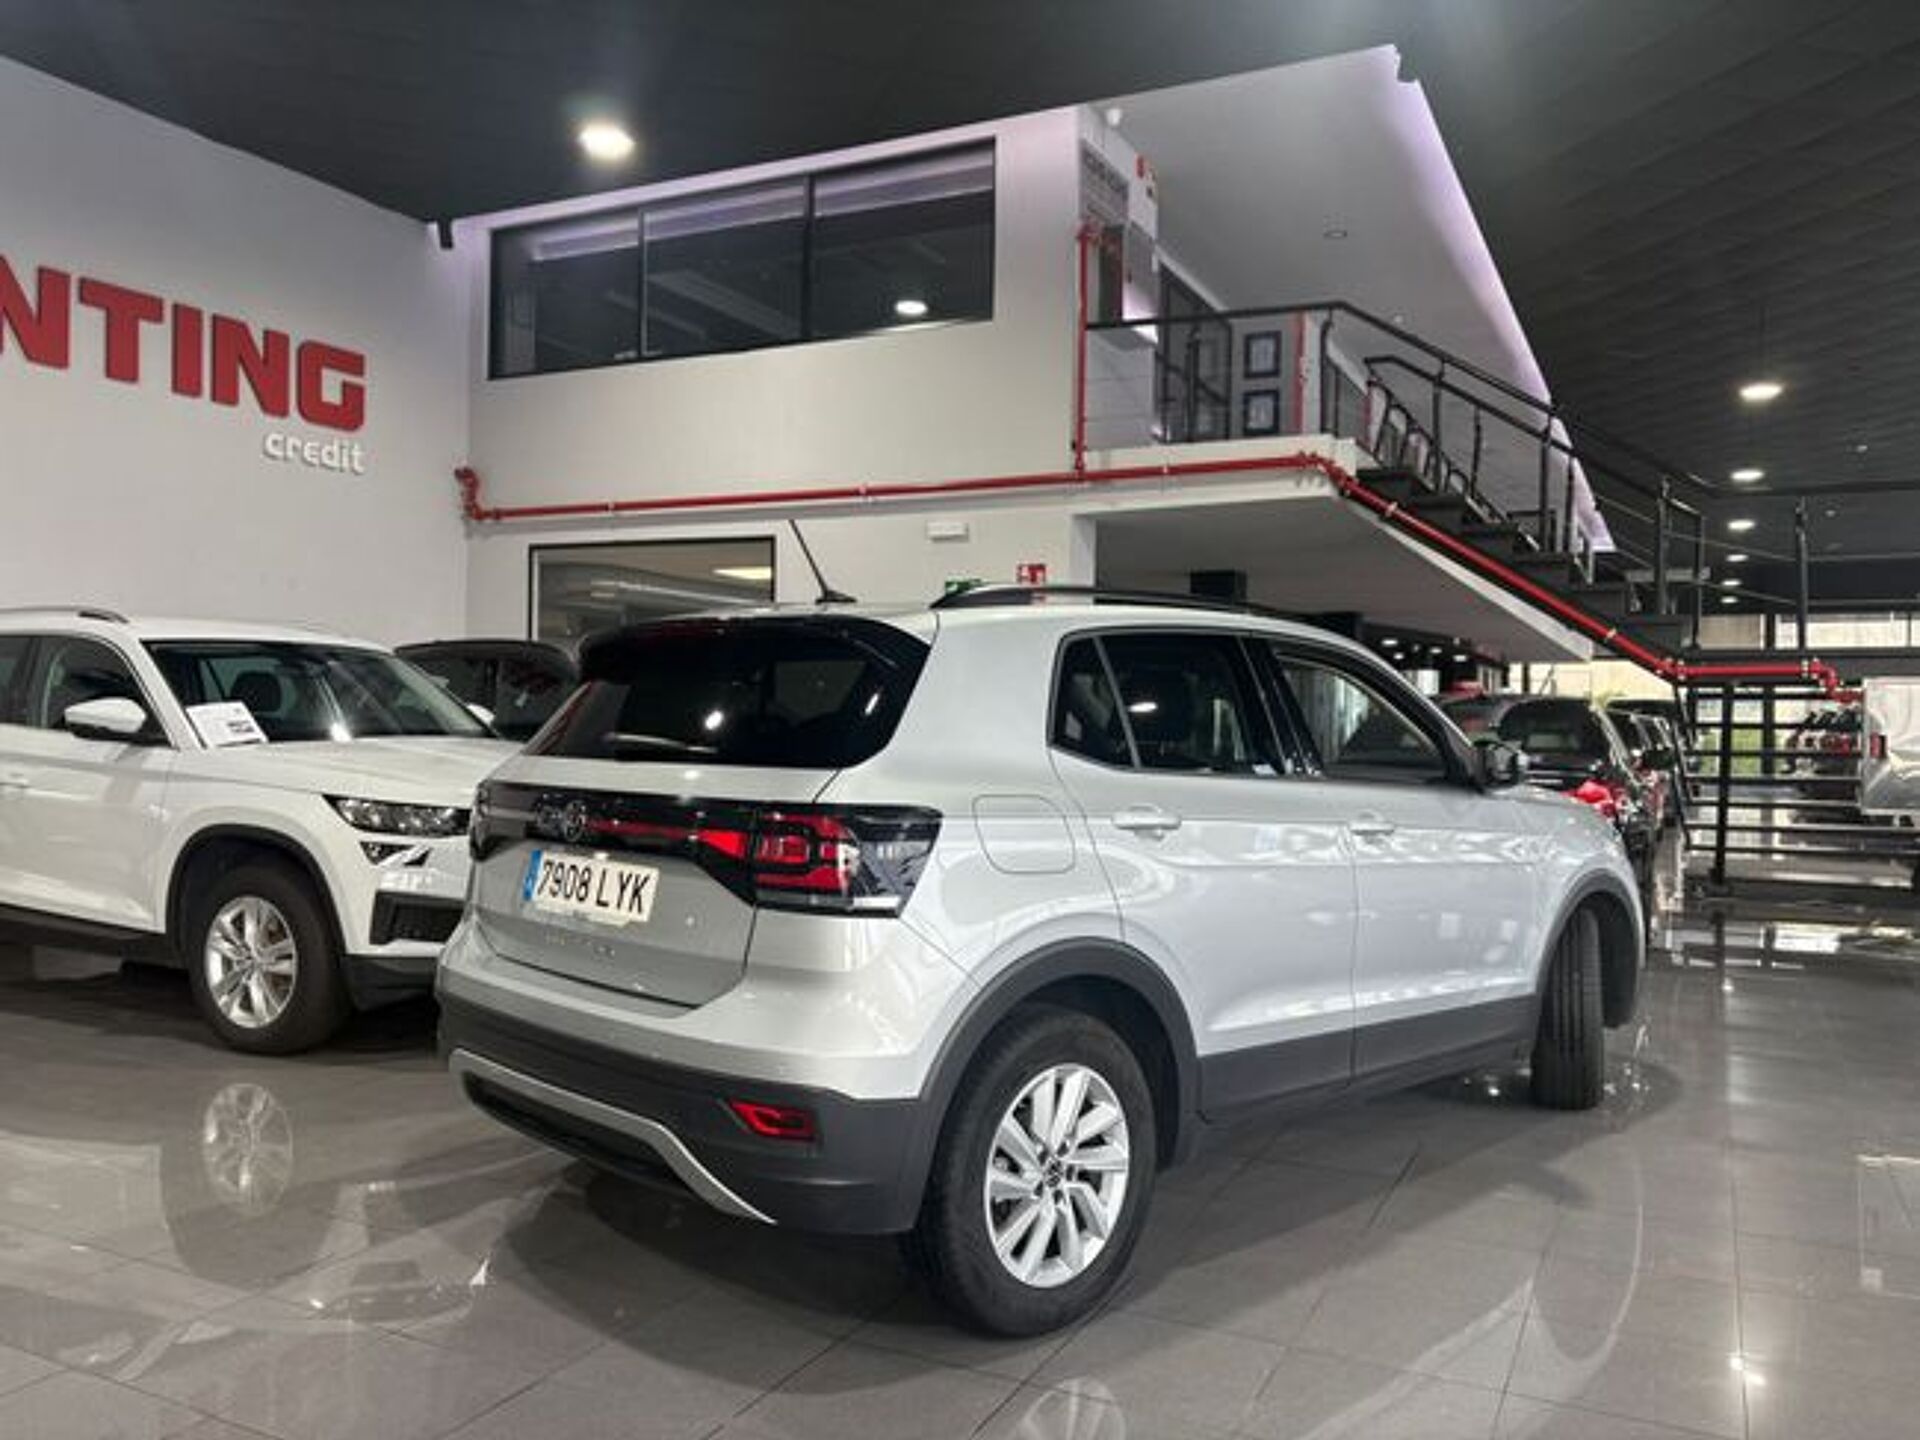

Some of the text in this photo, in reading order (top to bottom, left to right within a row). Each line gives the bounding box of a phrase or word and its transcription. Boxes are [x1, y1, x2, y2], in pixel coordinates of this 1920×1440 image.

[264, 431, 366, 475] credit
[537, 861, 650, 914] 7908 LYK
